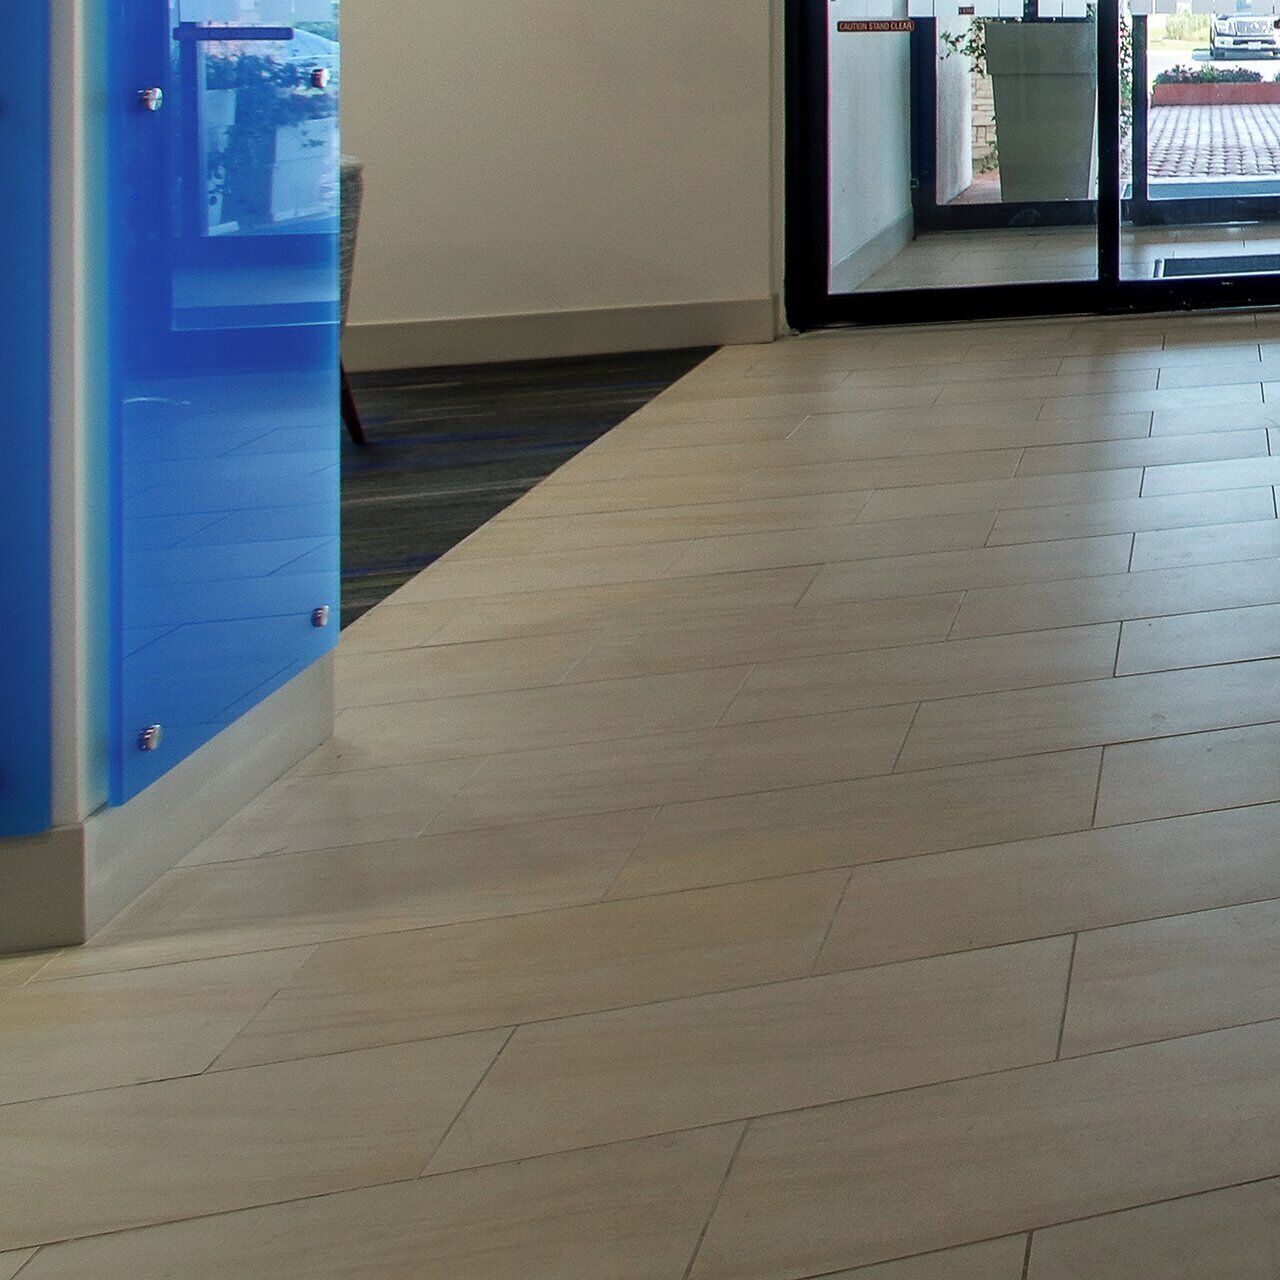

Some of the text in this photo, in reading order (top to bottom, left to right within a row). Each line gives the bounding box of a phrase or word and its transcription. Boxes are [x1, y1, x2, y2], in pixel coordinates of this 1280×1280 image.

[840, 21, 912, 31] CAUTION STAND CLEAR
